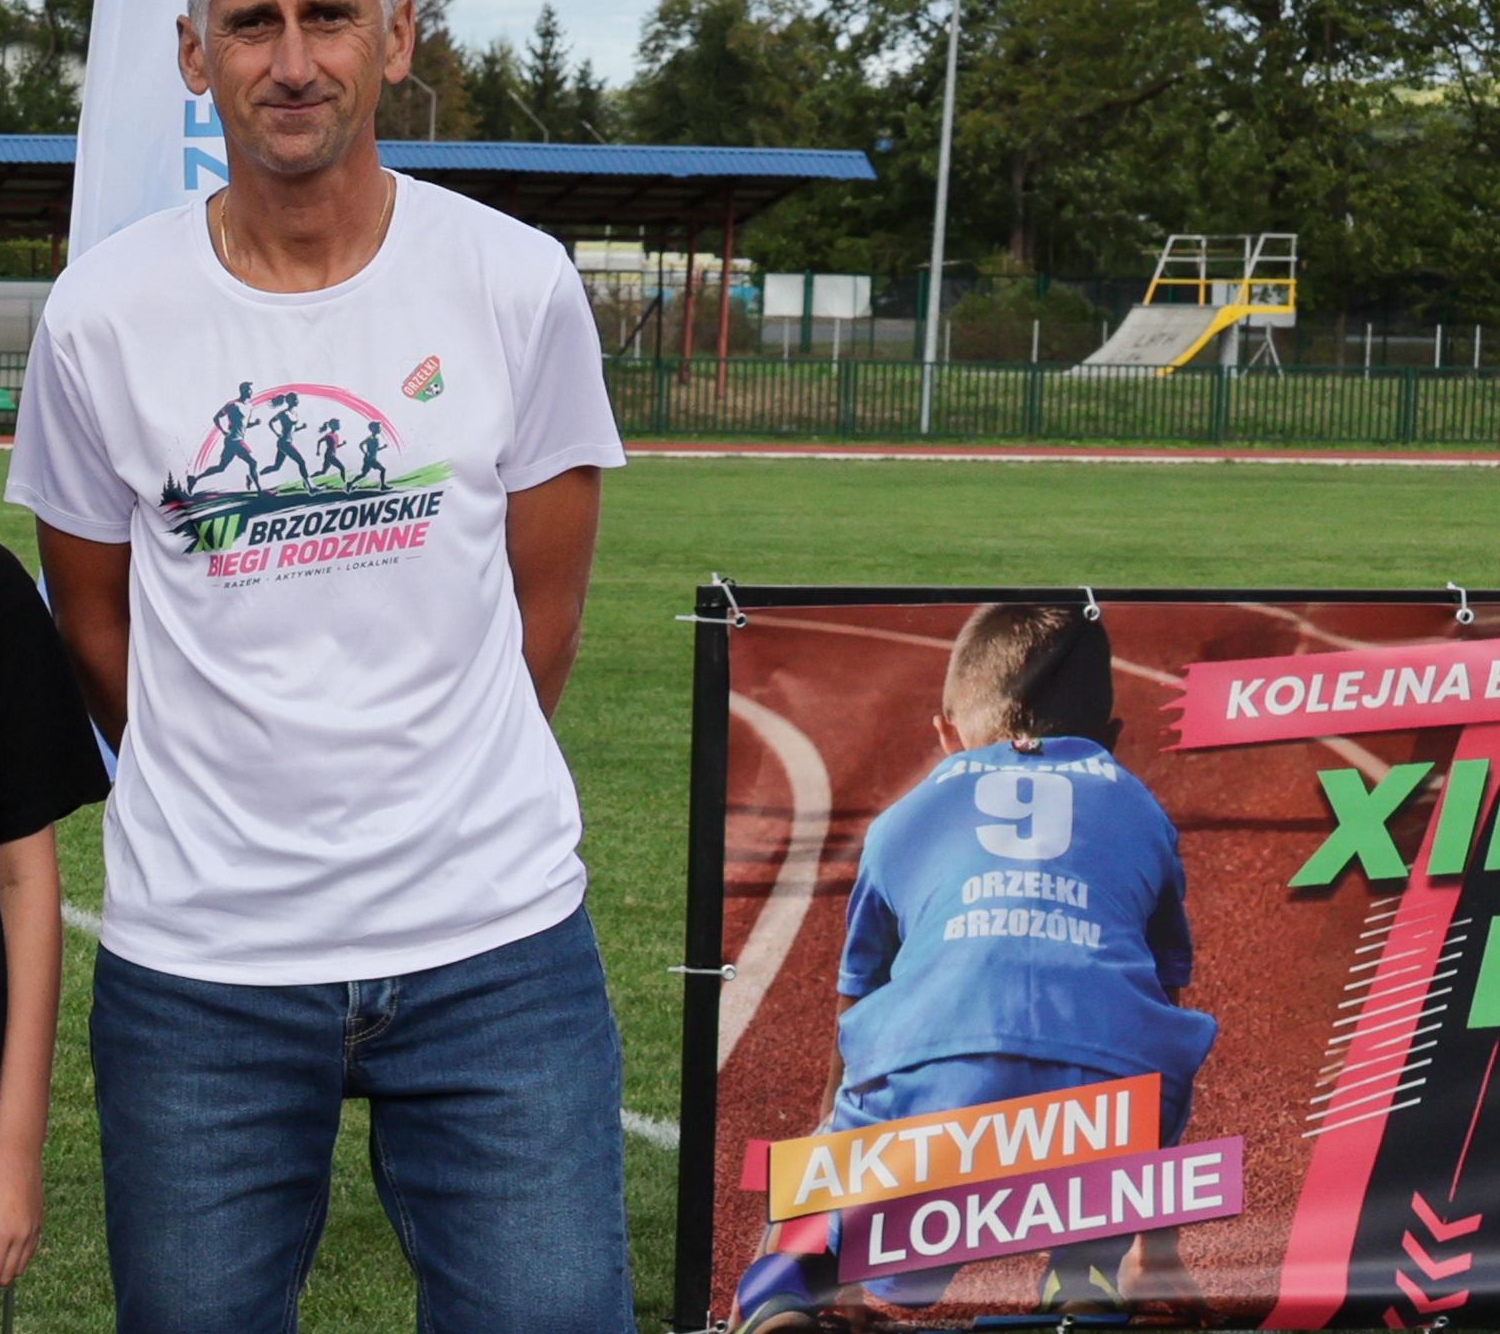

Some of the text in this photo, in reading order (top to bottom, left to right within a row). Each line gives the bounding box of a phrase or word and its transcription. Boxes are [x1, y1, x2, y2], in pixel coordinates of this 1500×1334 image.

[403, 357, 440, 397] ORZEŁKI
[191, 490, 444, 553] XII BRZOZOWSKIE
[206, 521, 431, 578] BIEGI RODZINNE
[223, 556, 400, 589] RAZEM AKTYWNIE LOKALNIE
[1226, 663, 1471, 720] KOLEJNA
[974, 771, 1073, 860] 9
[961, 869, 1088, 909] ORZEŁKI
[943, 908, 1103, 949] BRZOZÓW
[793, 1090, 1131, 1206] AKTYWNI
[866, 1152, 1225, 1267] LOKALNIE
